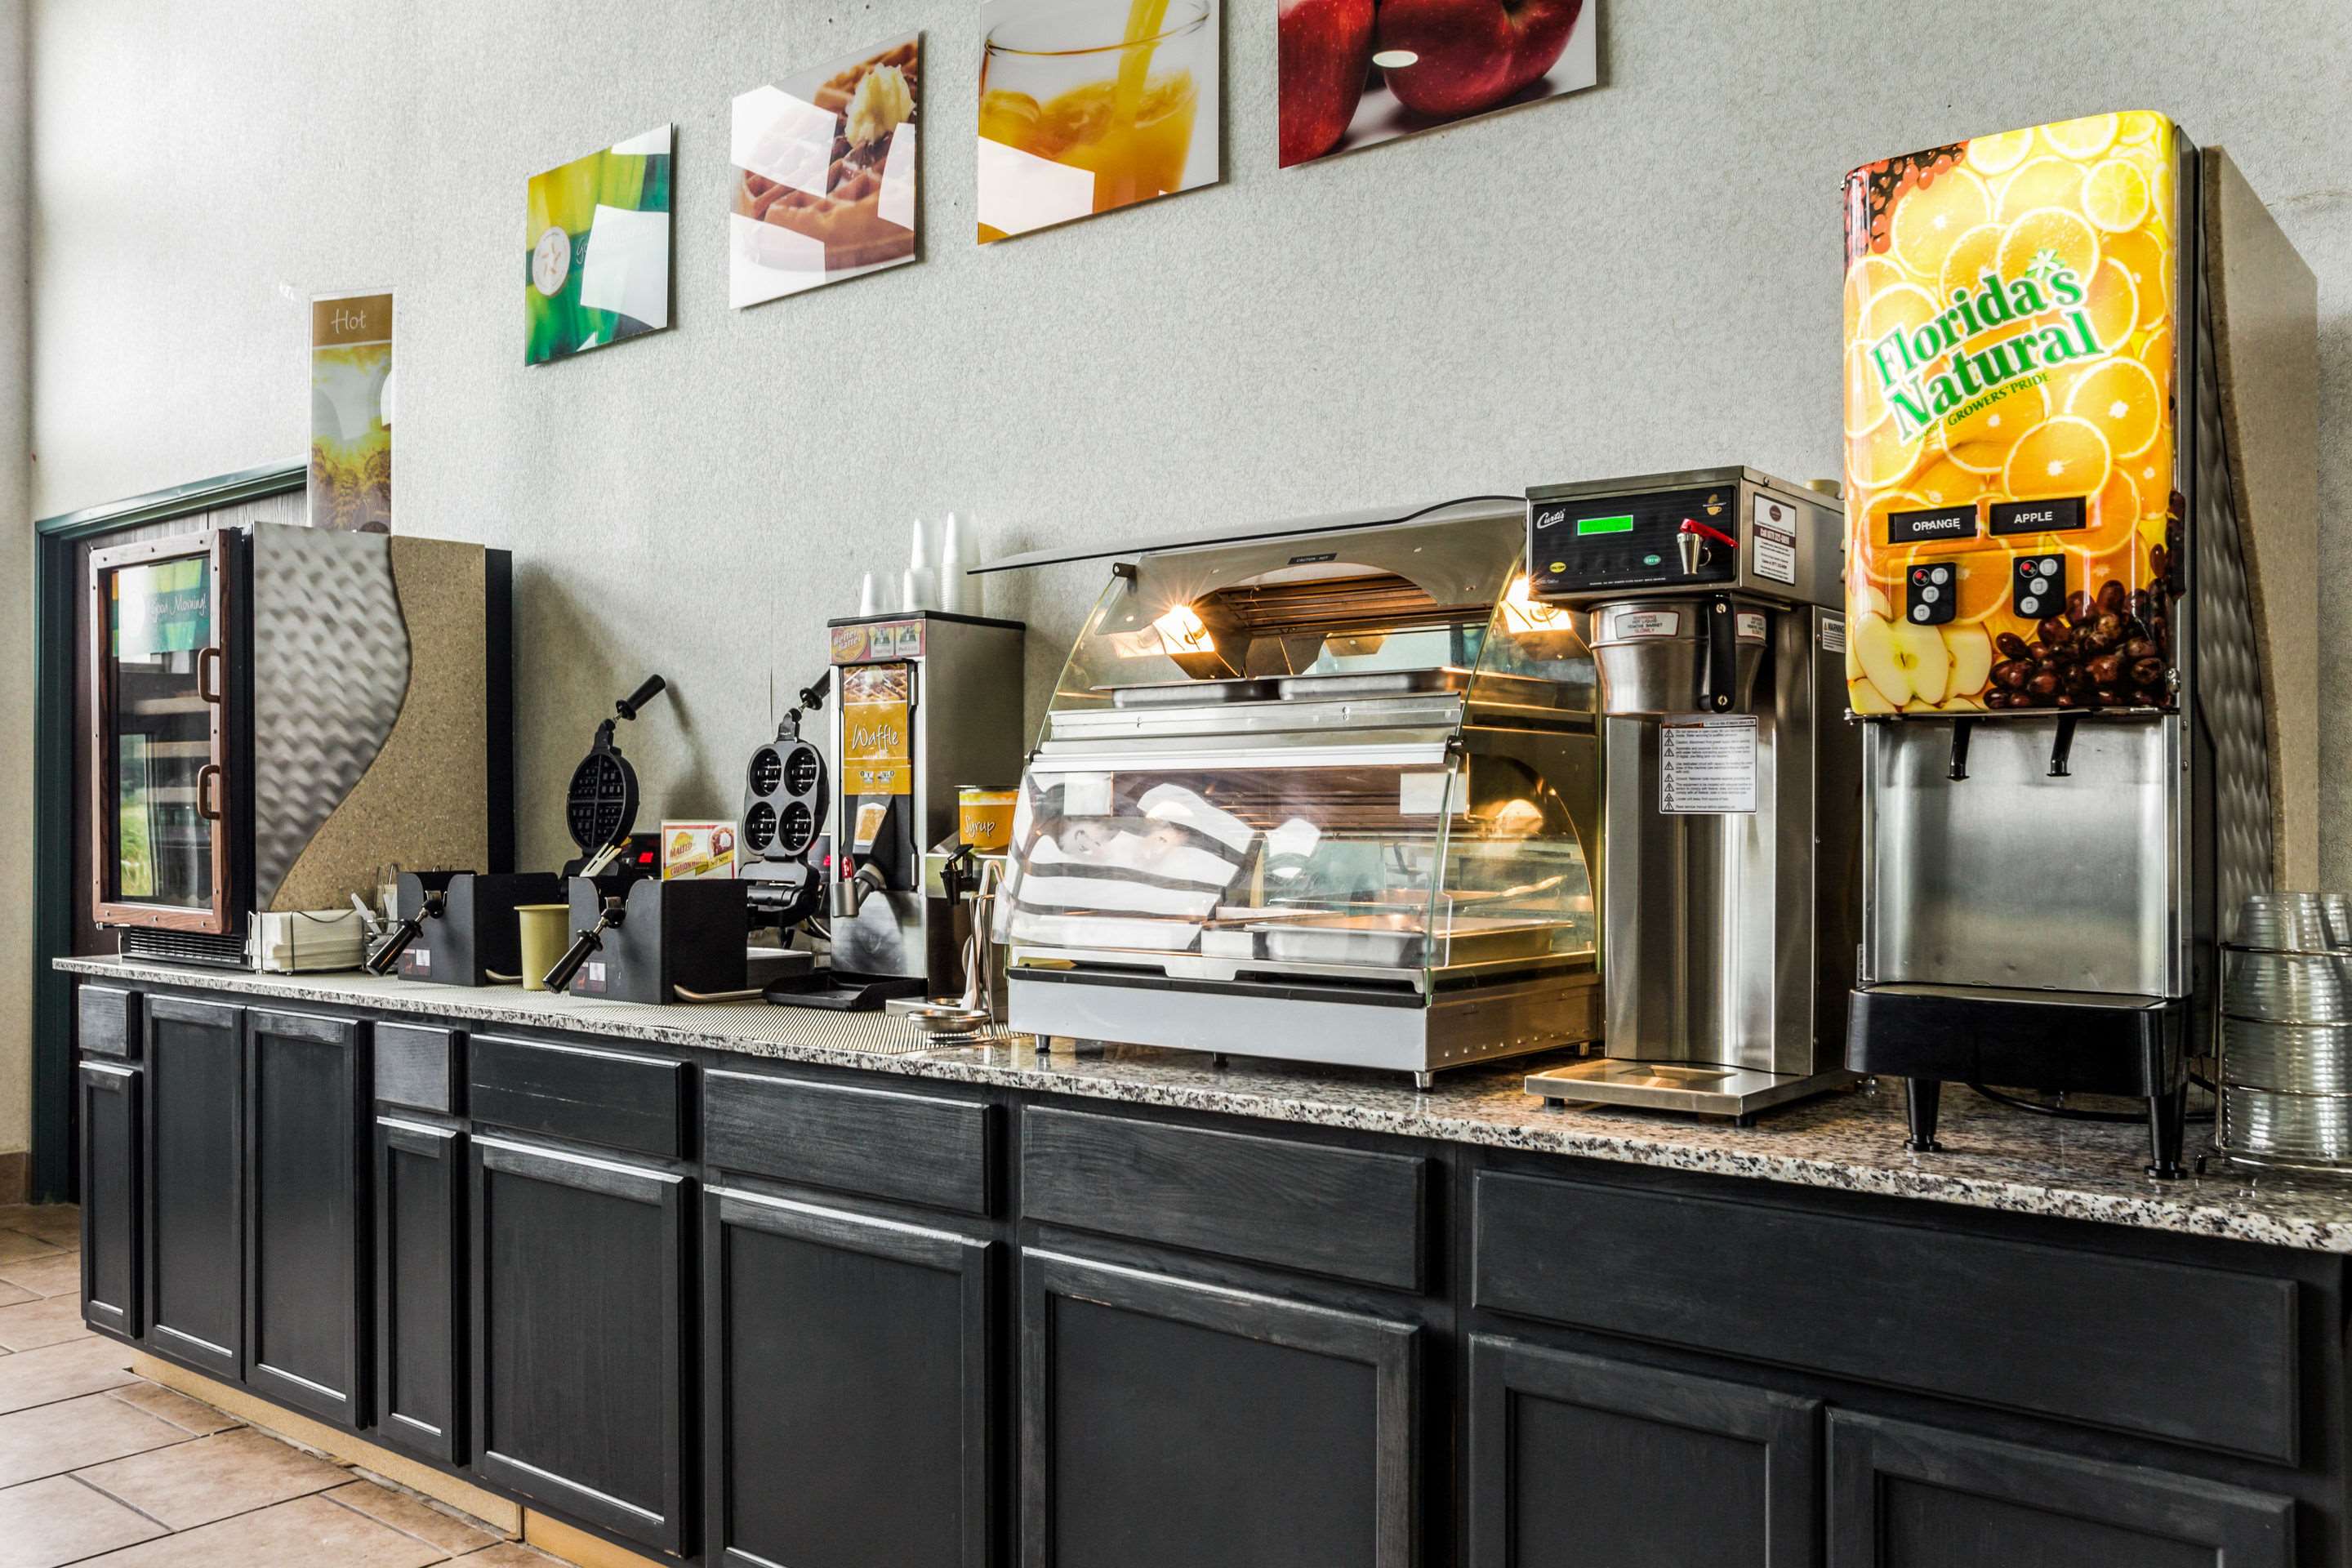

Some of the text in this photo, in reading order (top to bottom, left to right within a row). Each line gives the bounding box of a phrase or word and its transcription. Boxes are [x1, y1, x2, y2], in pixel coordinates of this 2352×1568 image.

[331, 308, 367, 334] Hot
[1889, 310, 2105, 441] Natural
[2009, 372, 2051, 394] PRIDE
[1536, 511, 1565, 529] Curtis
[1912, 517, 1961, 532] ORANGE
[2014, 511, 2053, 524] APPLE
[169, 594, 207, 617] Morning!
[852, 724, 899, 751] Waffle
[965, 815, 996, 838] Syrup
[670, 841, 693, 858] MALTED
